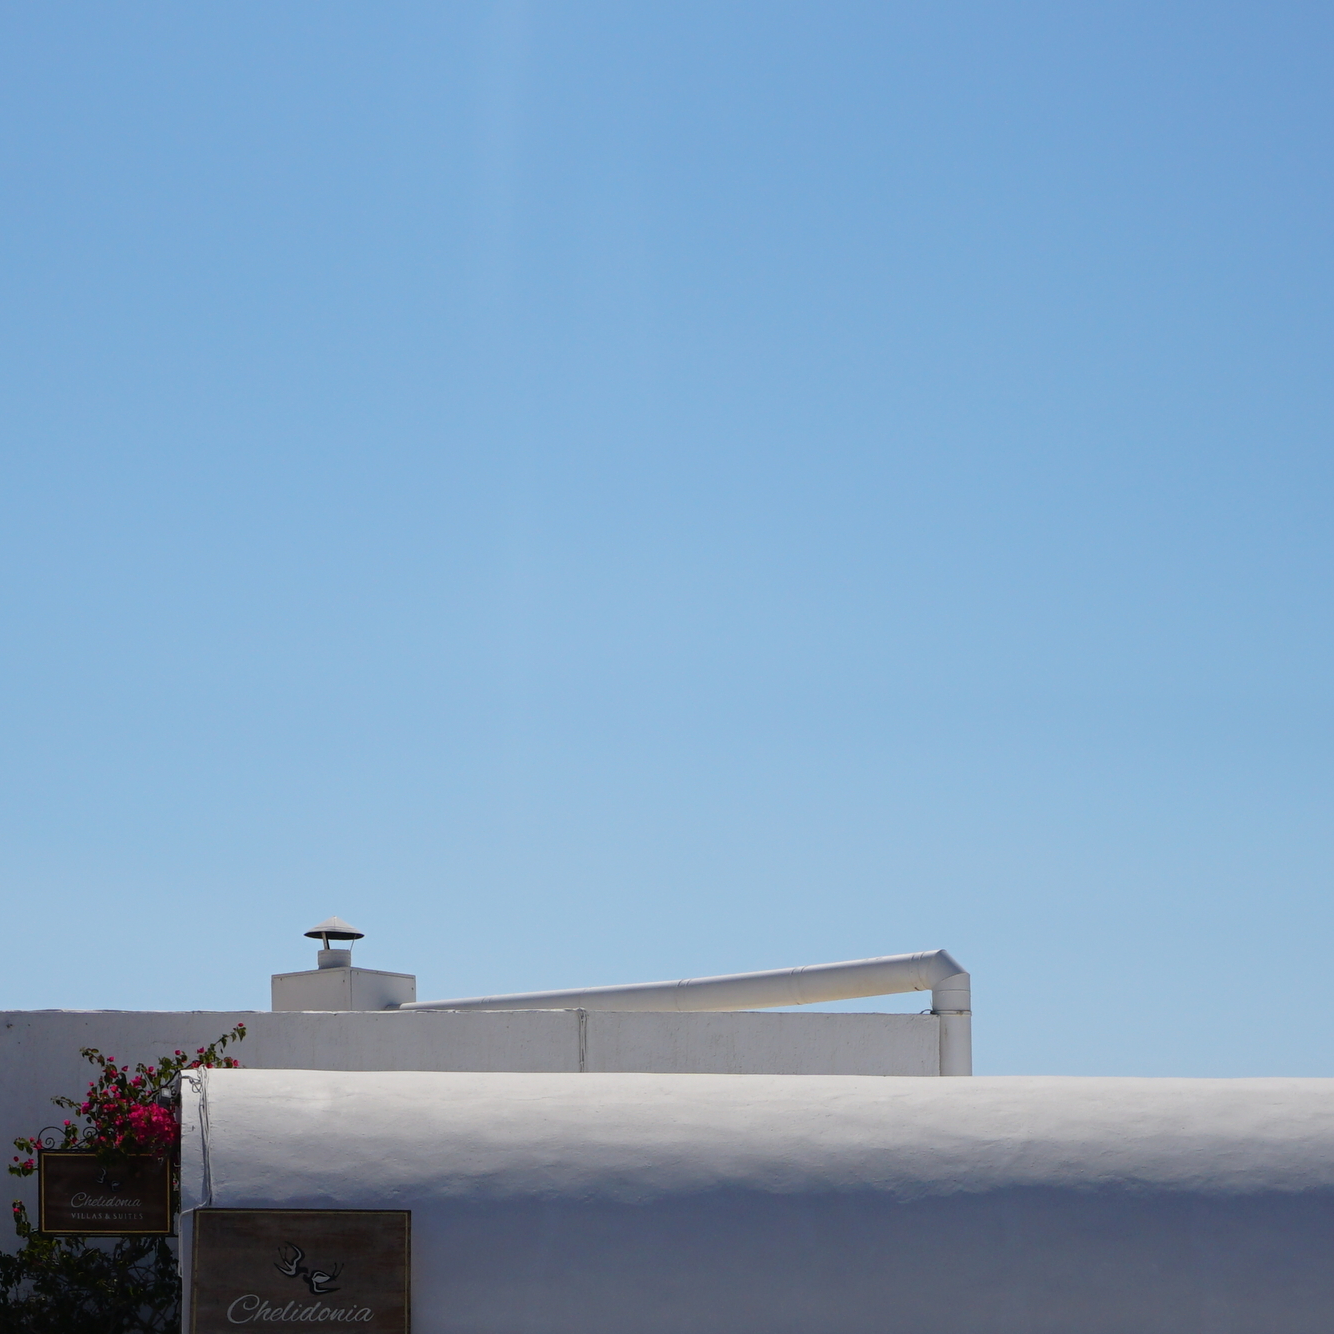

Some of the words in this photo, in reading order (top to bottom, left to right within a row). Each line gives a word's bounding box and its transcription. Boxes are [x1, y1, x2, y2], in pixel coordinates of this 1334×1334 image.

[70, 1191, 142, 1208] Chelidonia
[71, 1212, 102, 1220] VILLAS
[104, 1212, 111, 1220] &
[112, 1212, 144, 1220] SUITES
[226, 1293, 375, 1325] Chelidonia
